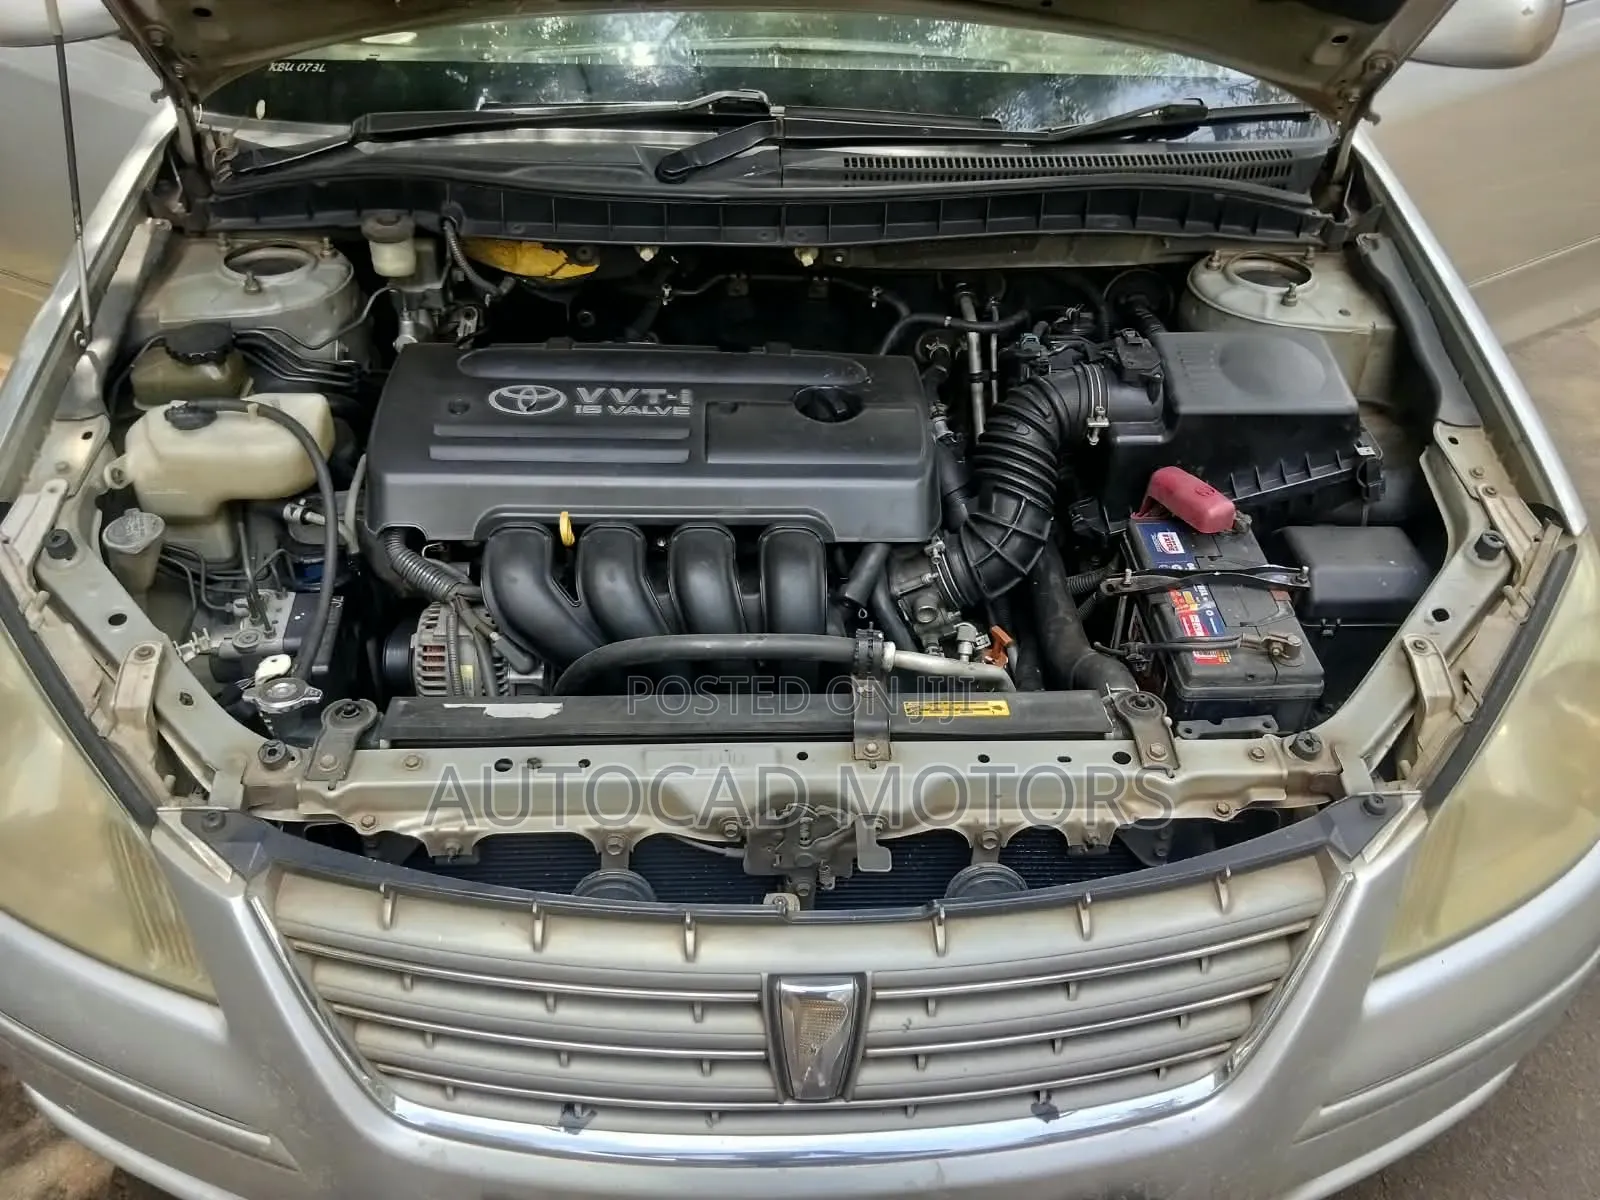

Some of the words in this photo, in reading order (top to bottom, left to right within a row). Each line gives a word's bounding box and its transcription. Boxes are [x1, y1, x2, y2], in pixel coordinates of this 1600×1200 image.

[268, 62, 295, 72] KBU
[297, 62, 327, 72] 073L
[575, 387, 693, 405] VVT-i
[573, 404, 603, 415] 16
[607, 405, 690, 415] VALVE
